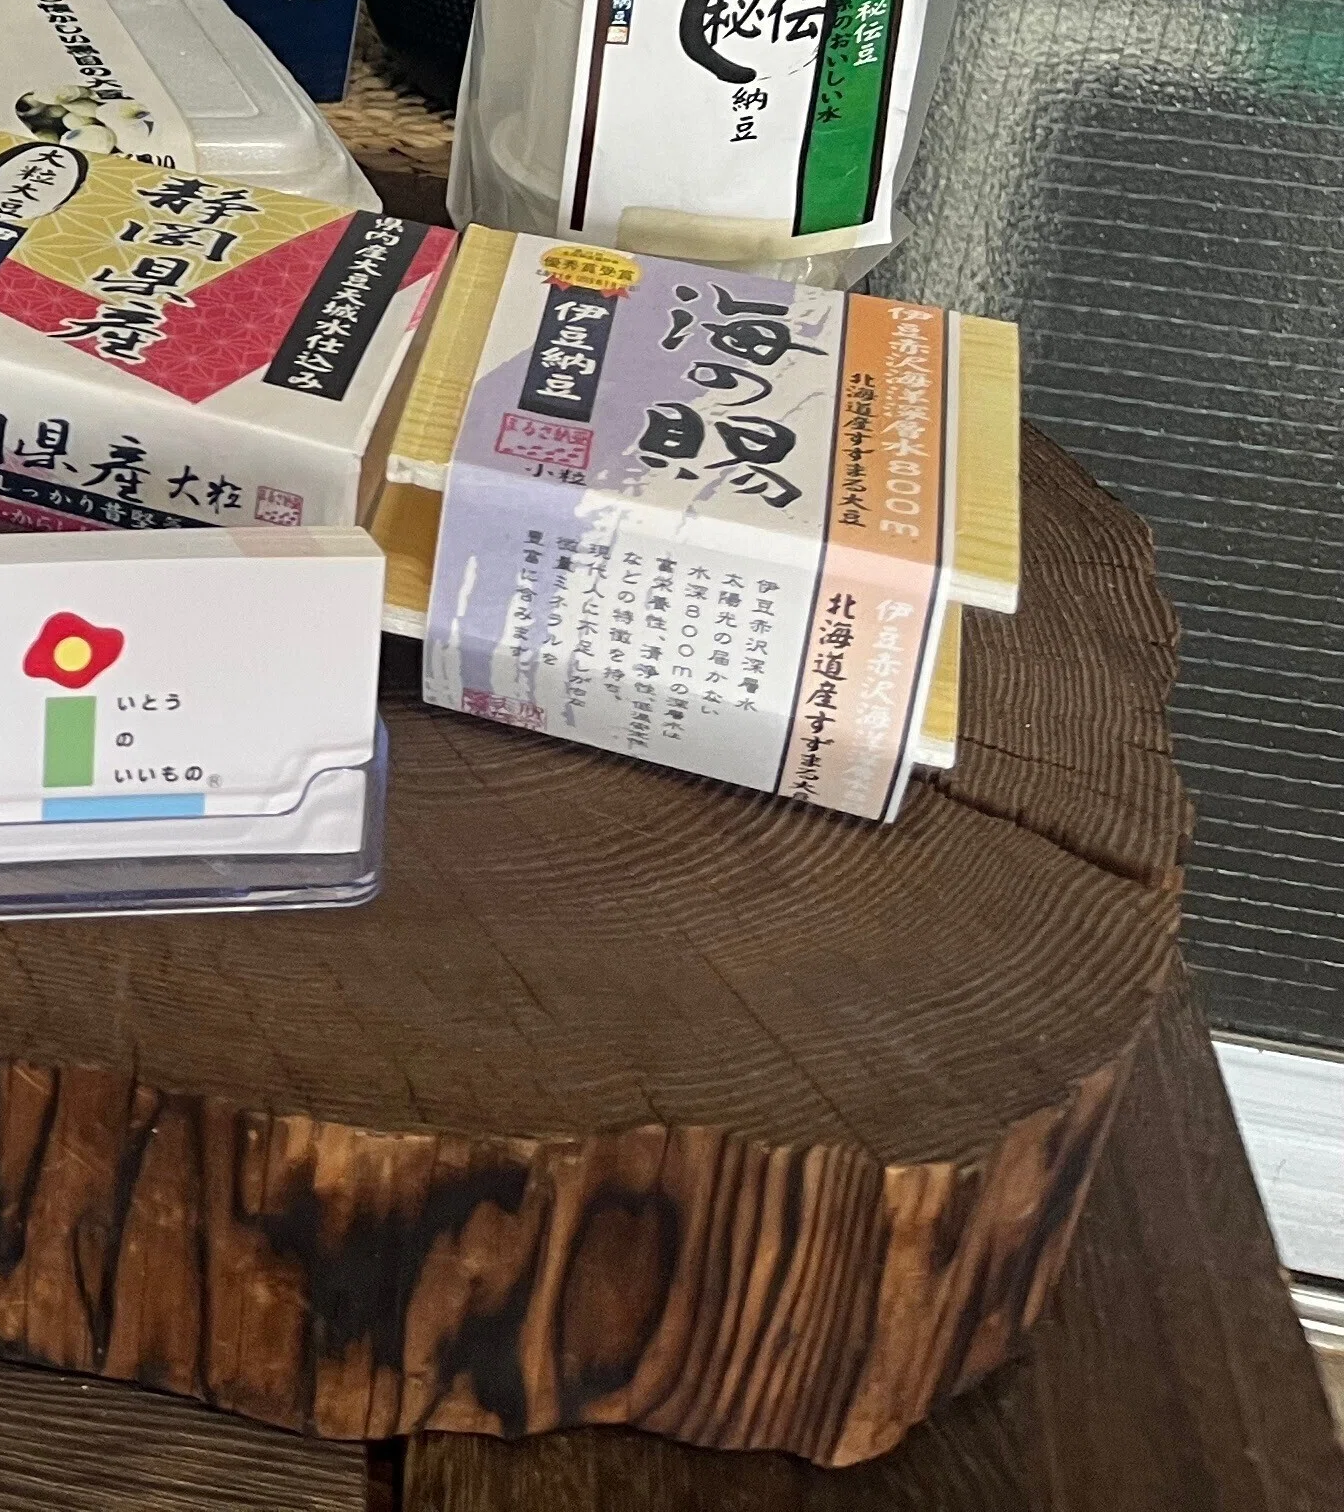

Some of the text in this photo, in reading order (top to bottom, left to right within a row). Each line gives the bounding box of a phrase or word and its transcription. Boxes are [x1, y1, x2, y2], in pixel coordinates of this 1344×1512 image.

[730, 86, 769, 143] 納豆
[0, 149, 67, 219] 大粒大豆
[46, 175, 261, 362] 静岡県産
[542, 256, 636, 282] 優秀賞受賞
[287, 216, 404, 390] 県内産大豆天城水仕込み
[536, 300, 610, 402] 伊豆納豆
[167, 464, 243, 515] 大粒
[525, 463, 588, 486] 小粒
[700, 573, 745, 716] 太陽光の届かない
[735, 579, 781, 713] 伊豆赤沢深層水
[116, 693, 181, 711] いとう
[115, 731, 134, 748] の
[114, 765, 204, 783] いいもの
